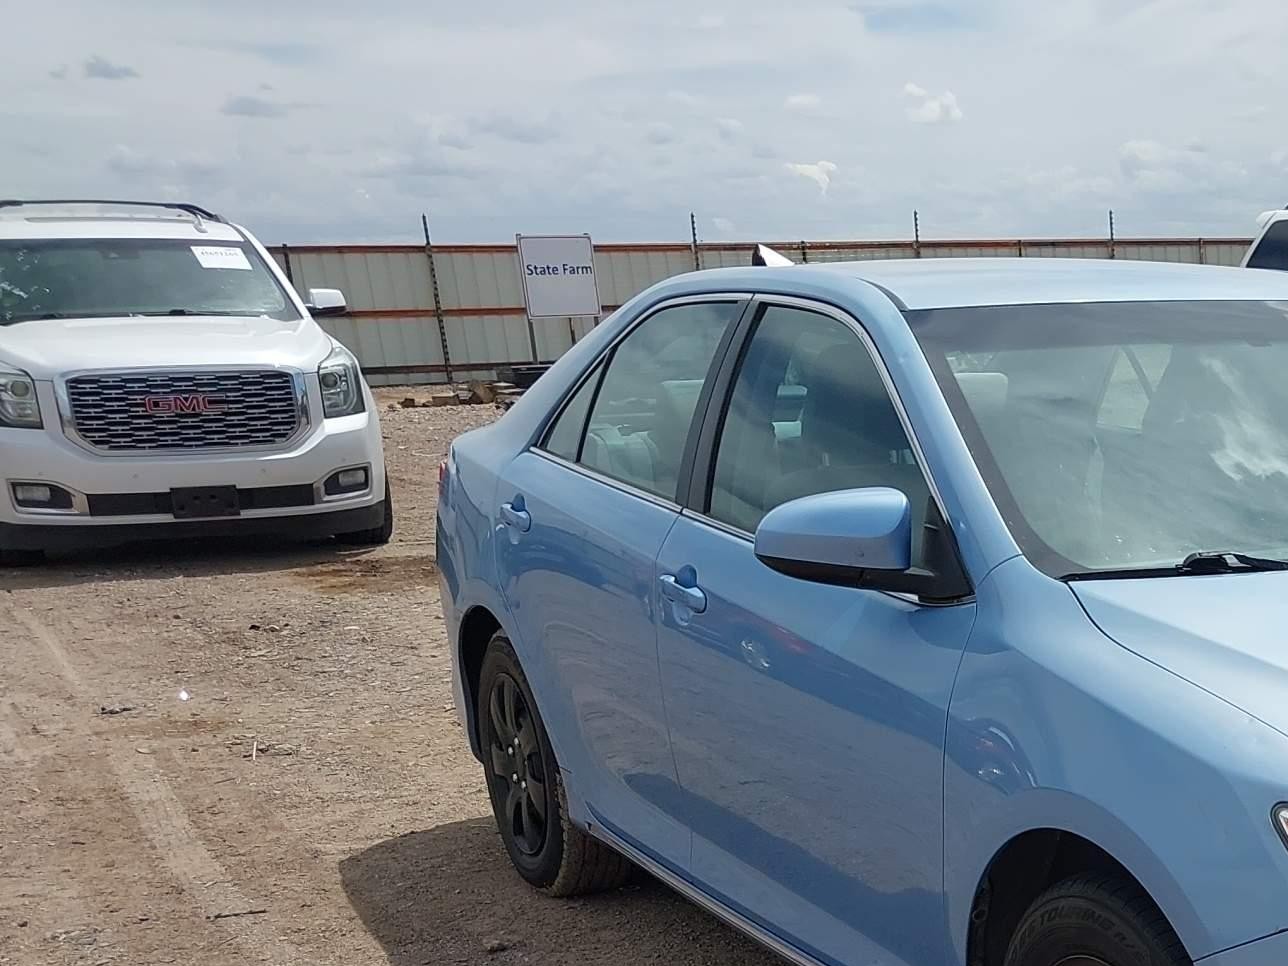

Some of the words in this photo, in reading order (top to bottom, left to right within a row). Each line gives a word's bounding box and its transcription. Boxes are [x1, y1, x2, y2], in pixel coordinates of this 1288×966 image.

[526, 264, 559, 276] State
[563, 264, 592, 275] Farm
[145, 394, 226, 414] GMC
